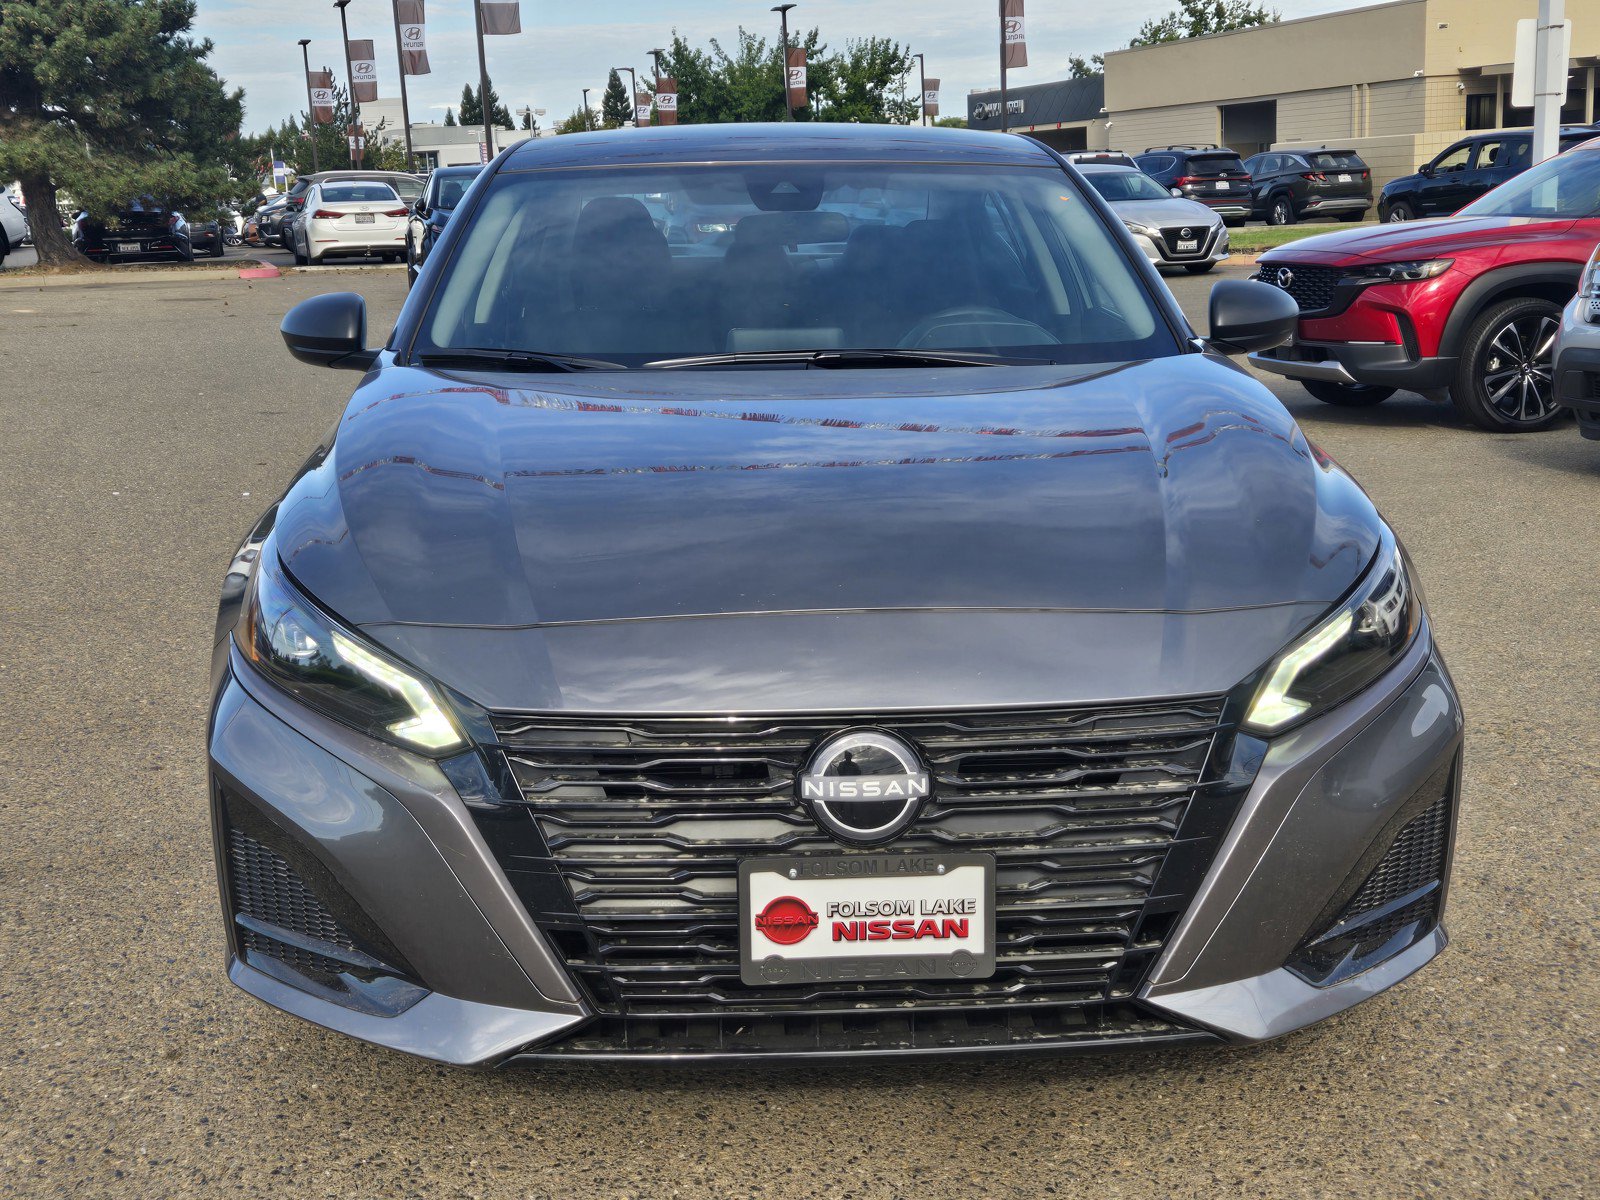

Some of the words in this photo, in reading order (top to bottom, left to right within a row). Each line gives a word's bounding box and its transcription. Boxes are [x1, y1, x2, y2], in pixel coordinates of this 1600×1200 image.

[804, 777, 927, 799] NISSAN
[799, 858, 878, 877] FOLSOM
[884, 857, 935, 874] LAKE
[826, 899, 915, 917] FOLSOM
[921, 897, 977, 915] LAKE
[755, 911, 819, 927] NISSAN
[832, 917, 970, 941] NISSAN
[800, 958, 936, 979] NISSAN
